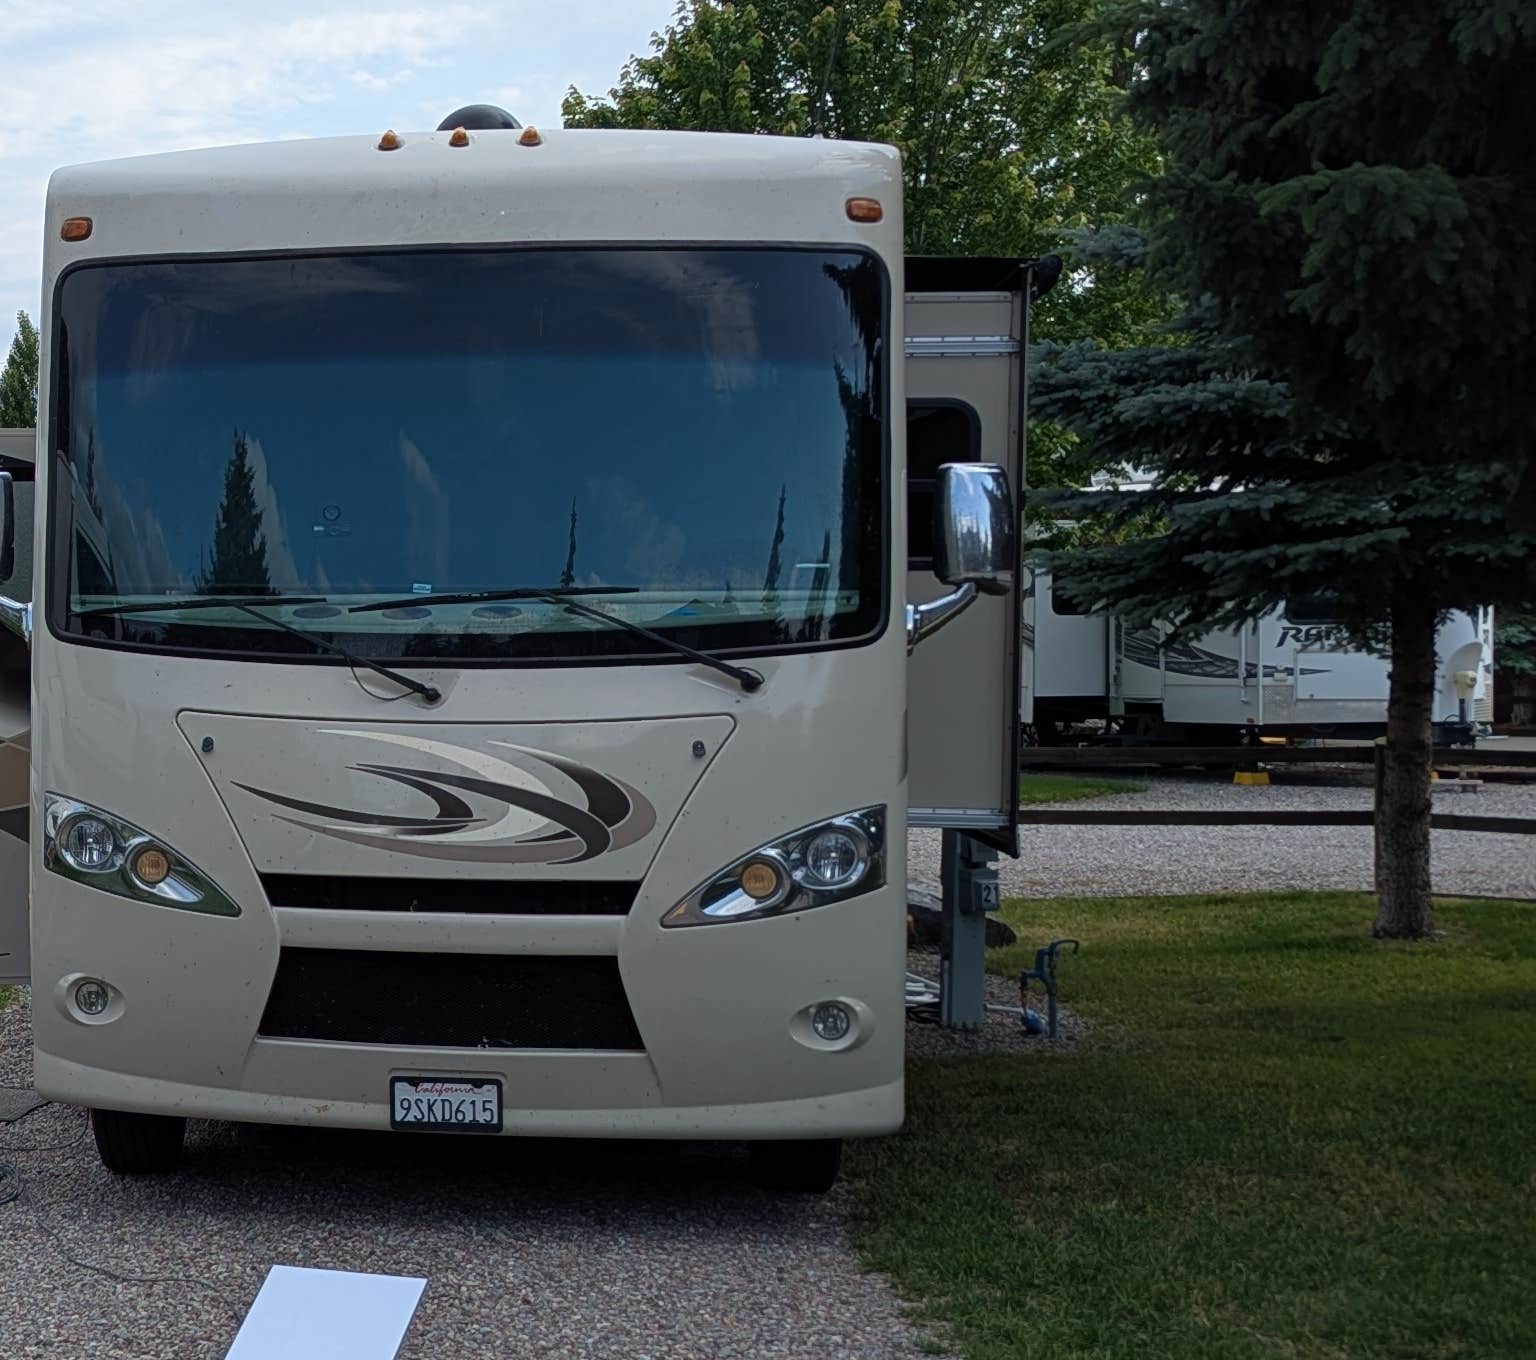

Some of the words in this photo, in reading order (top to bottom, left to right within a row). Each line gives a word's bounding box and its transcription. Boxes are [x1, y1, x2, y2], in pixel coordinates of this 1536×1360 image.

[983, 884, 999, 904] 21
[415, 1082, 481, 1097] California
[400, 1097, 495, 1123] 9SKD615
